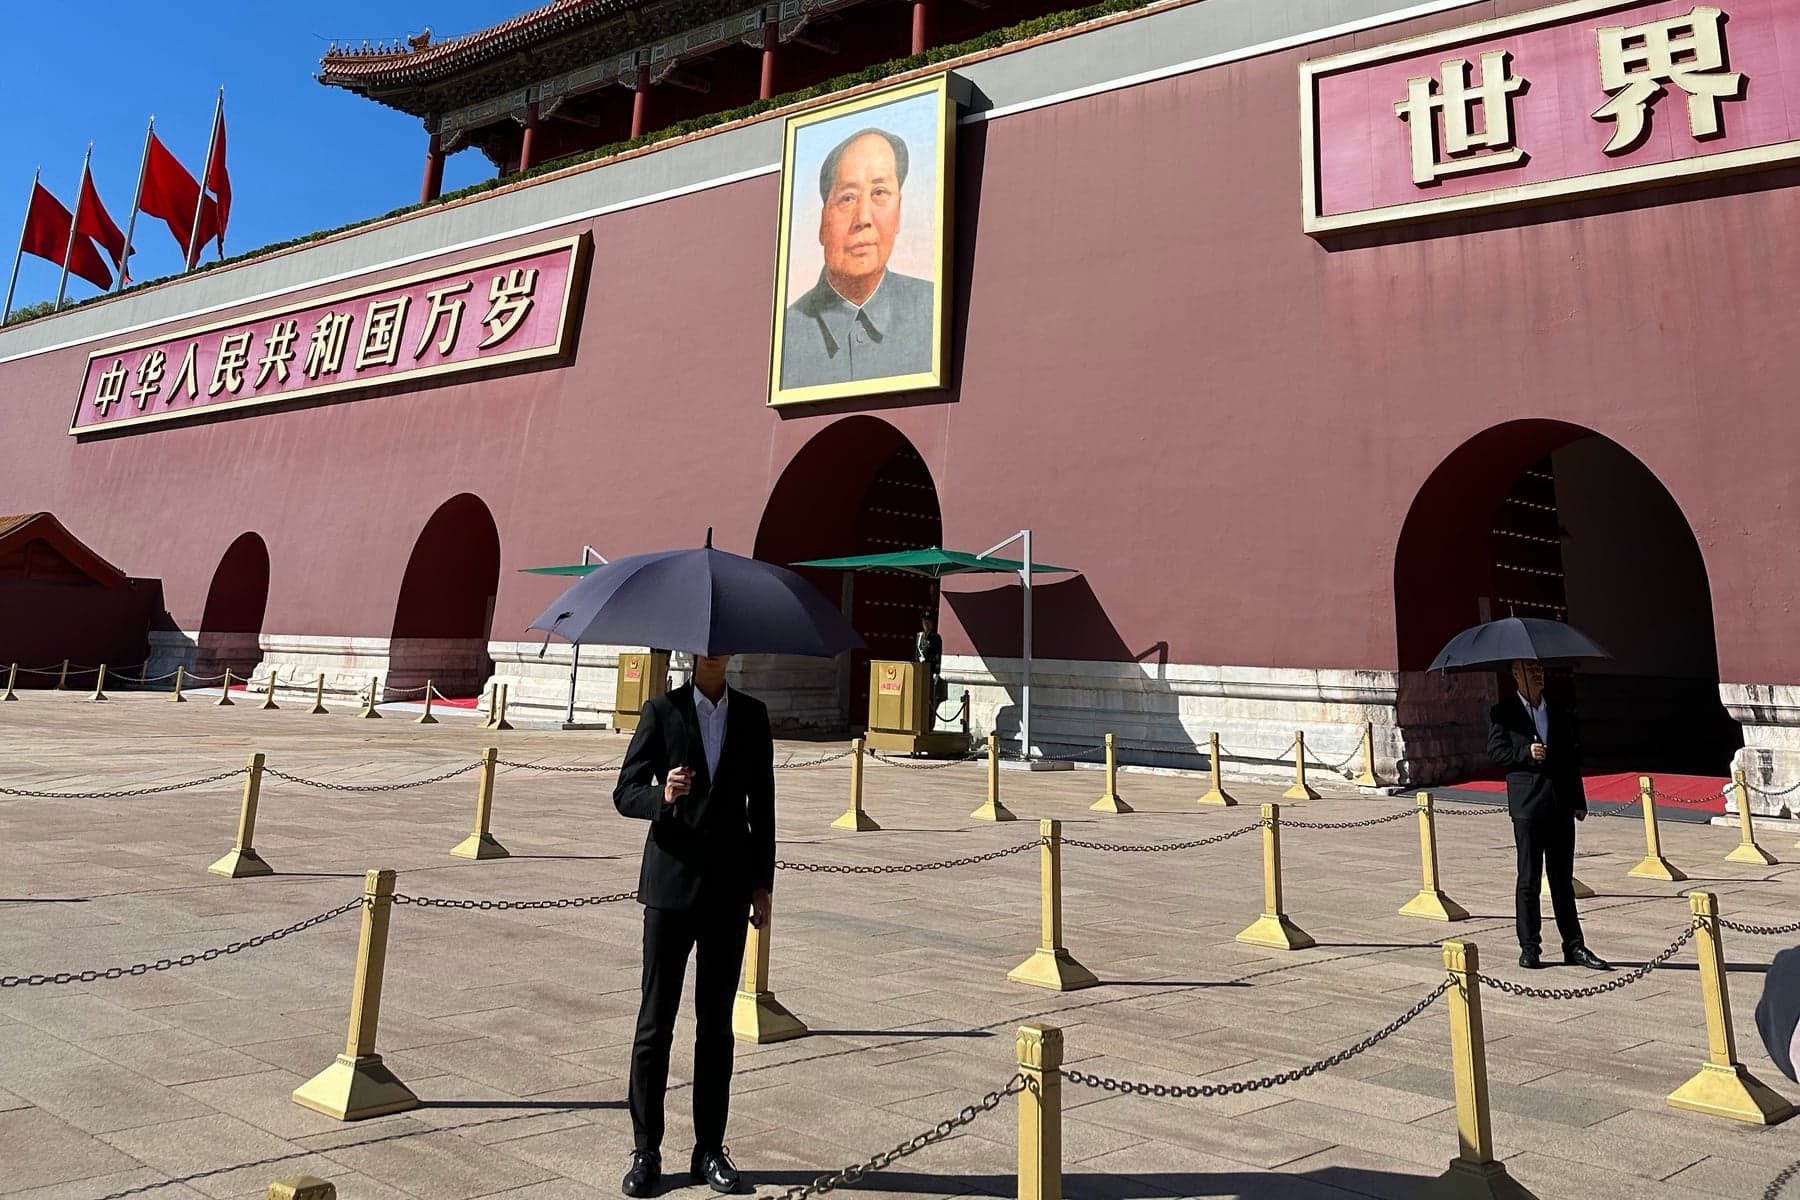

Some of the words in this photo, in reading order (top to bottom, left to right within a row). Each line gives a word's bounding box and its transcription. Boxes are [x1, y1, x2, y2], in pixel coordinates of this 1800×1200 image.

[1394, 6, 1742, 185] 世界
[93, 267, 537, 415] 中华人民共和国万岁
